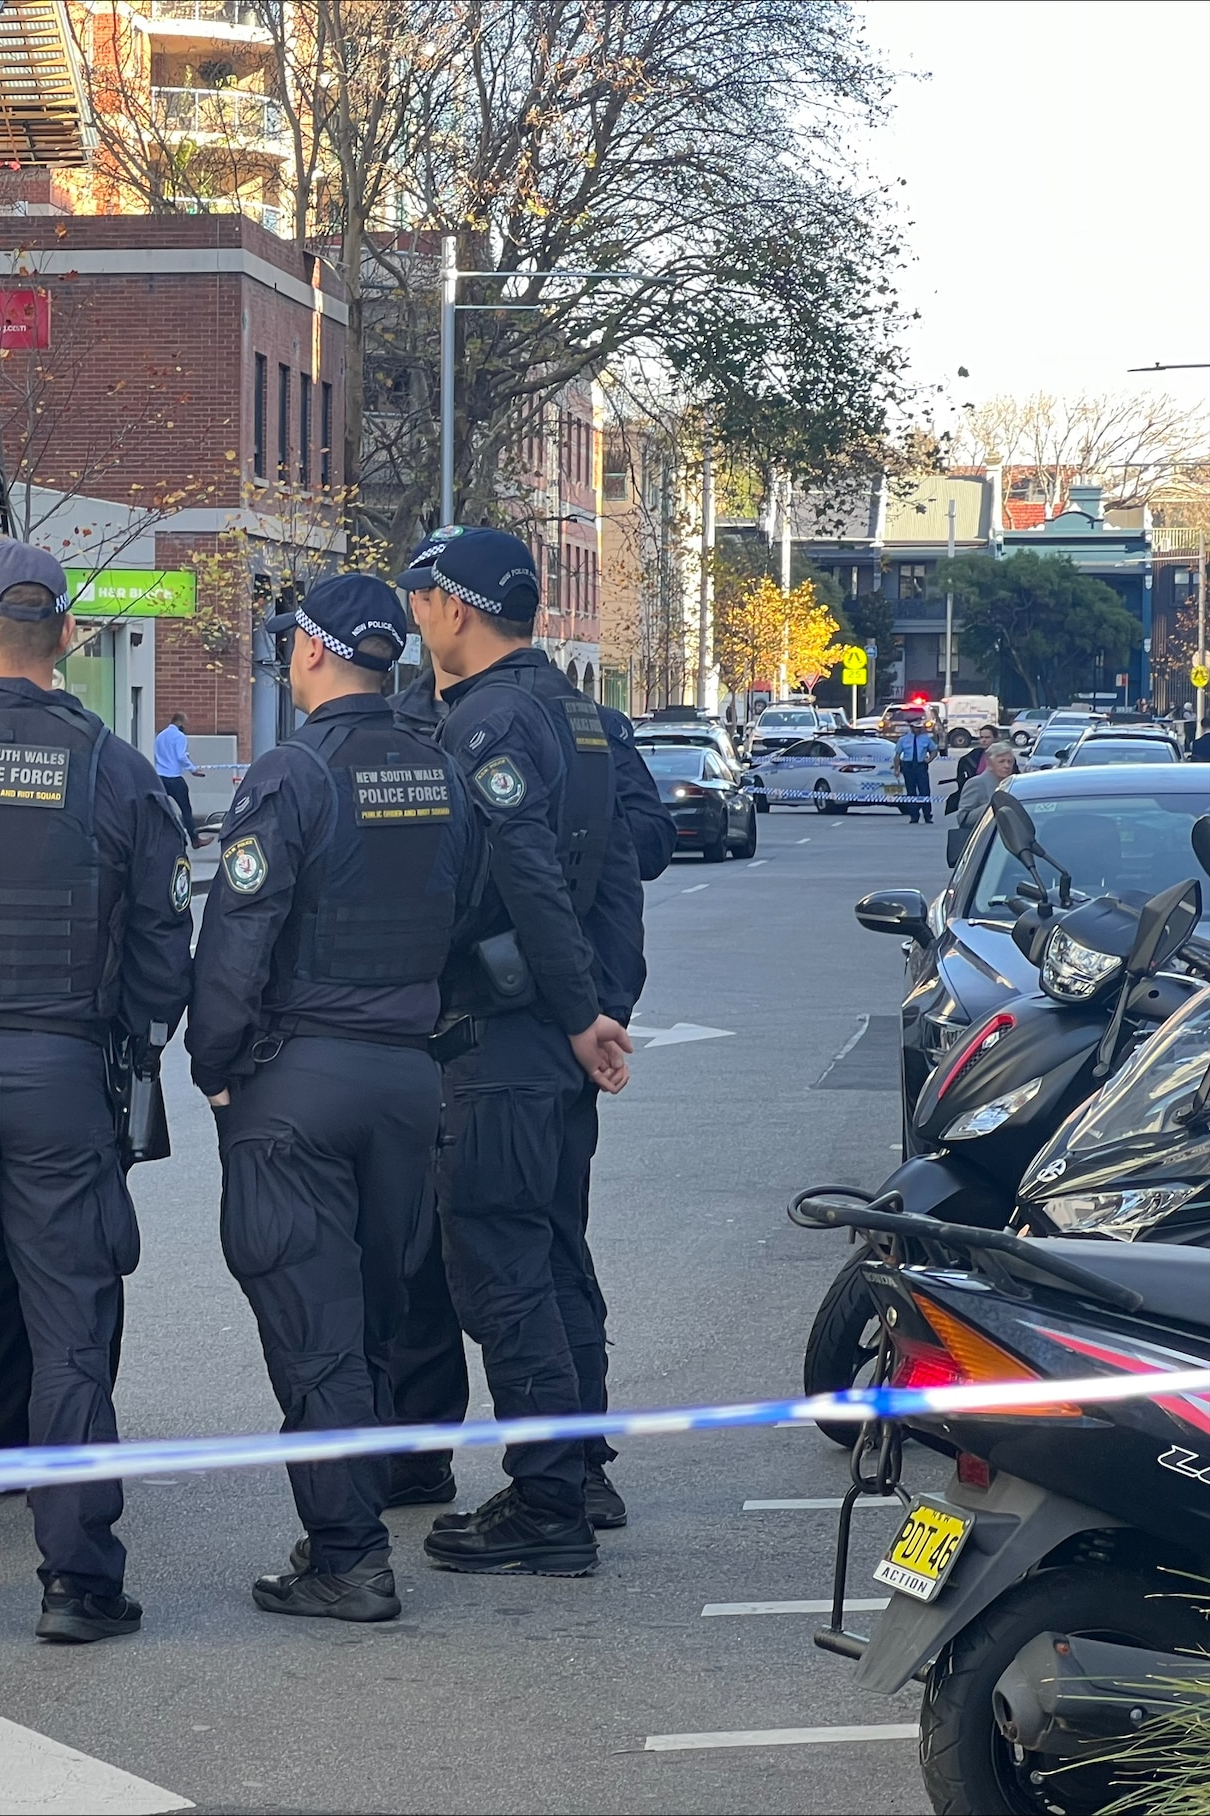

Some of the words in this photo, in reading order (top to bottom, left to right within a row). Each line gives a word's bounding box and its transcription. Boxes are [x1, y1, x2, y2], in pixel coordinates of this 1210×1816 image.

[99, 587, 125, 598] H&R
[368, 621, 392, 631] POLICE
[25, 751, 65, 765] WALES
[11, 767, 63, 786] FORCE
[356, 771, 378, 783] NEW
[380, 770, 412, 782] SOUTH
[414, 769, 444, 781] WALES
[0, 789, 16, 797] AND
[17, 790, 35, 798] RIOT
[36, 791, 61, 800] SQUAD
[358, 788, 405, 803] POLICE
[407, 786, 448, 802] FORCE
[881, 1566, 928, 1593] ACTION
